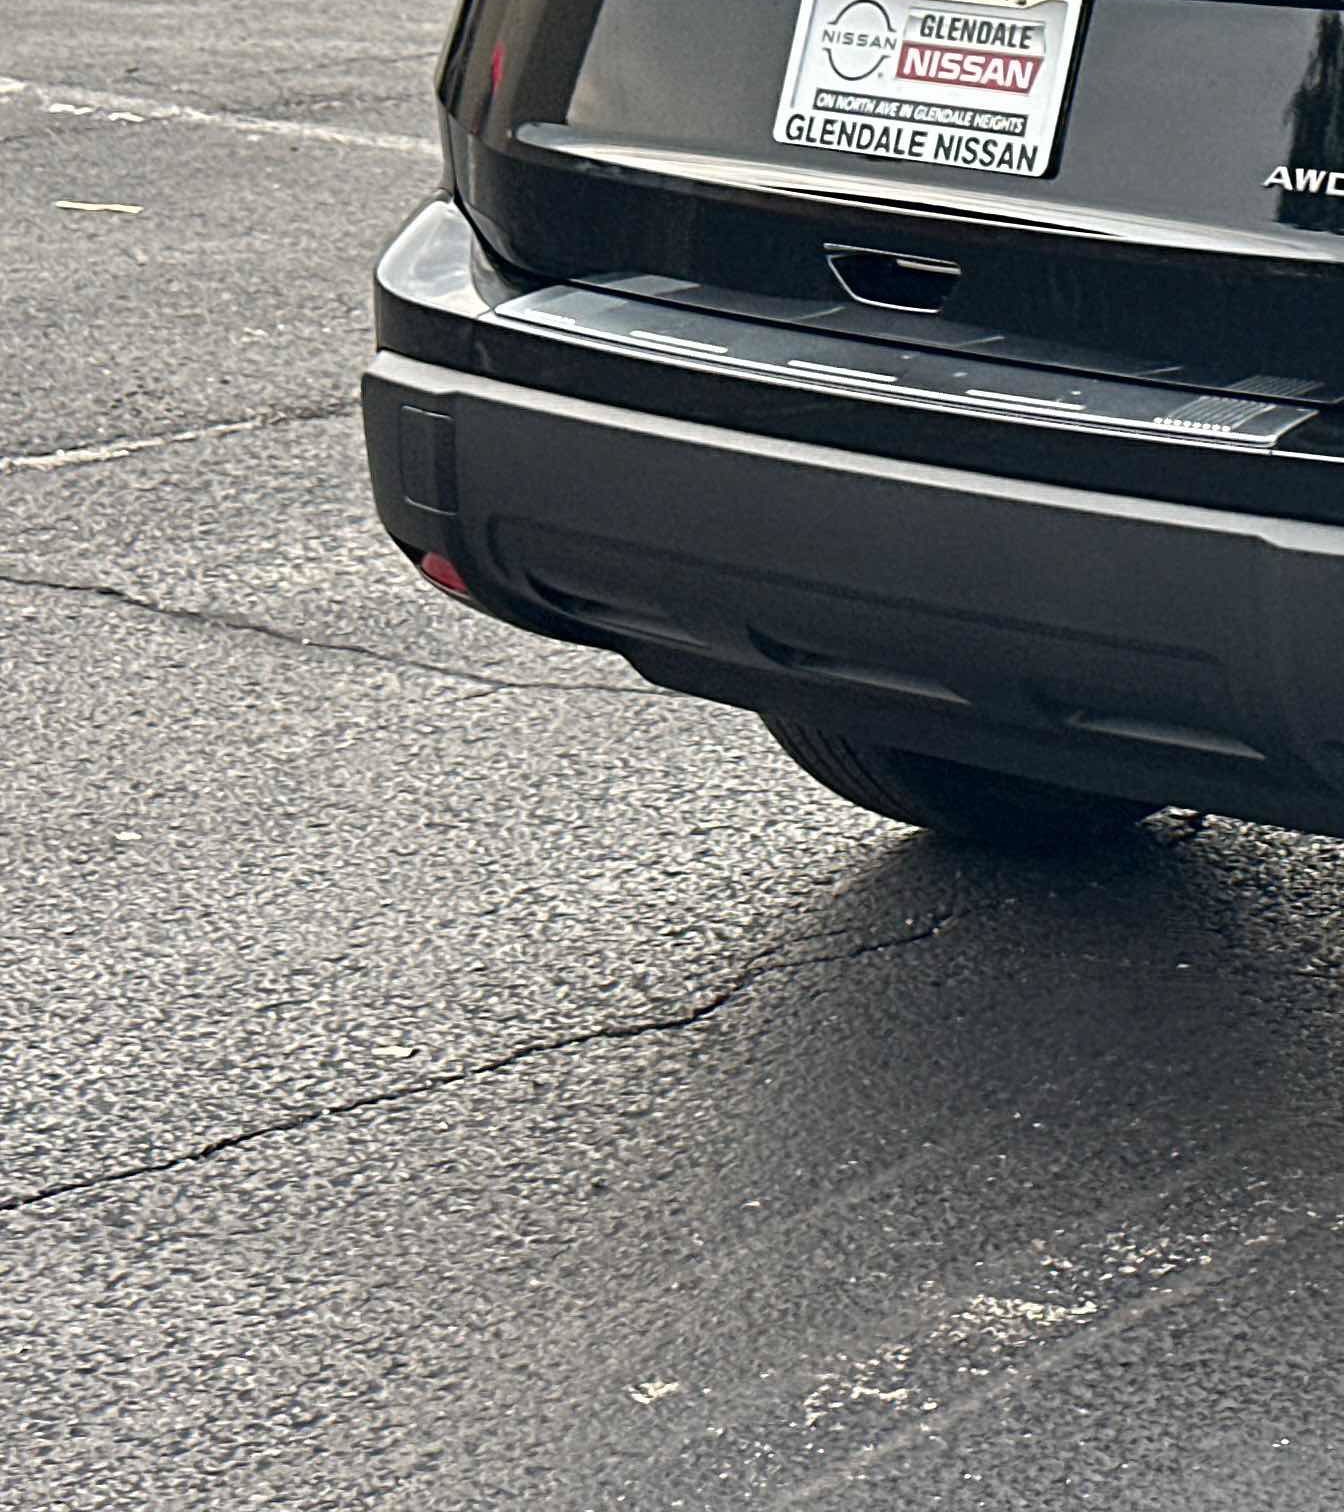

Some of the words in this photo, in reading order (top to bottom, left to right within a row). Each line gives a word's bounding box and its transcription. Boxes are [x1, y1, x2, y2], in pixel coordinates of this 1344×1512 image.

[822, 29, 897, 51] NISSAN
[920, 13, 1034, 50] GLENDALE
[902, 47, 1034, 89] NISSAN
[816, 92, 836, 108] ON
[835, 94, 876, 113] NORTH
[874, 100, 899, 117] AVE
[914, 105, 974, 127] GLENDALE
[974, 112, 1025, 134] HEIGHTS
[785, 114, 929, 158] GLENDALE
[933, 133, 1039, 172] NISSAN
